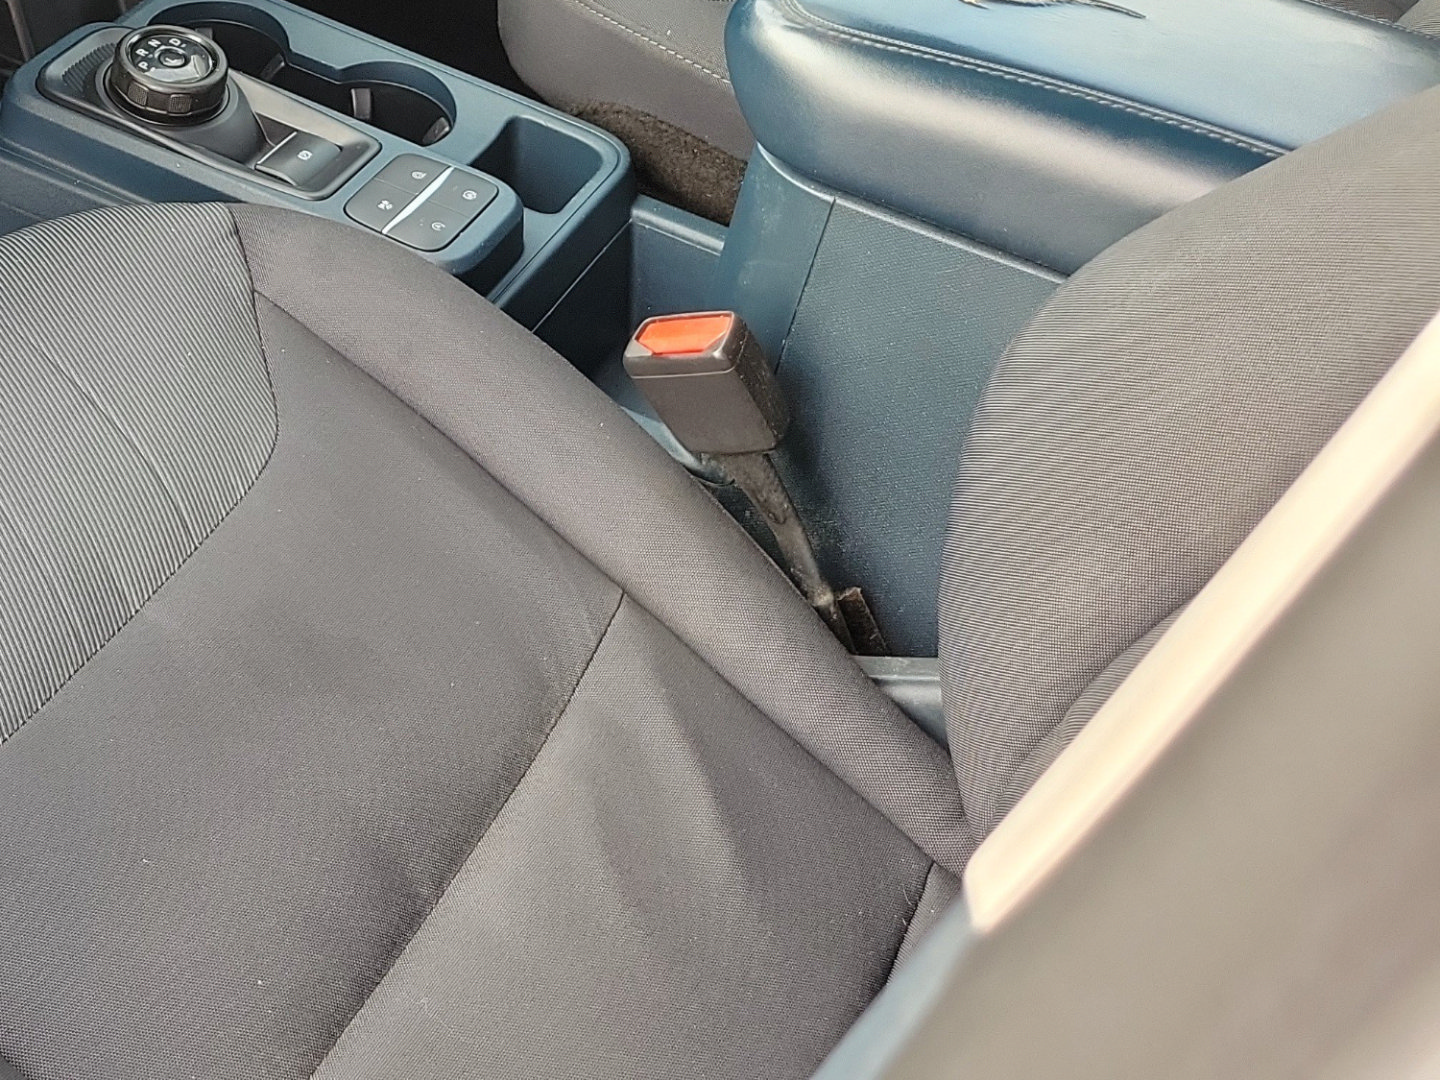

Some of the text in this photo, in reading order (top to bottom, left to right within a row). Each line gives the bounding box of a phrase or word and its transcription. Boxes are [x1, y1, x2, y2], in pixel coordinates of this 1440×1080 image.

[148, 38, 162, 48] N
[168, 38, 181, 46] D
[135, 48, 149, 57] R
[137, 61, 148, 70] P
